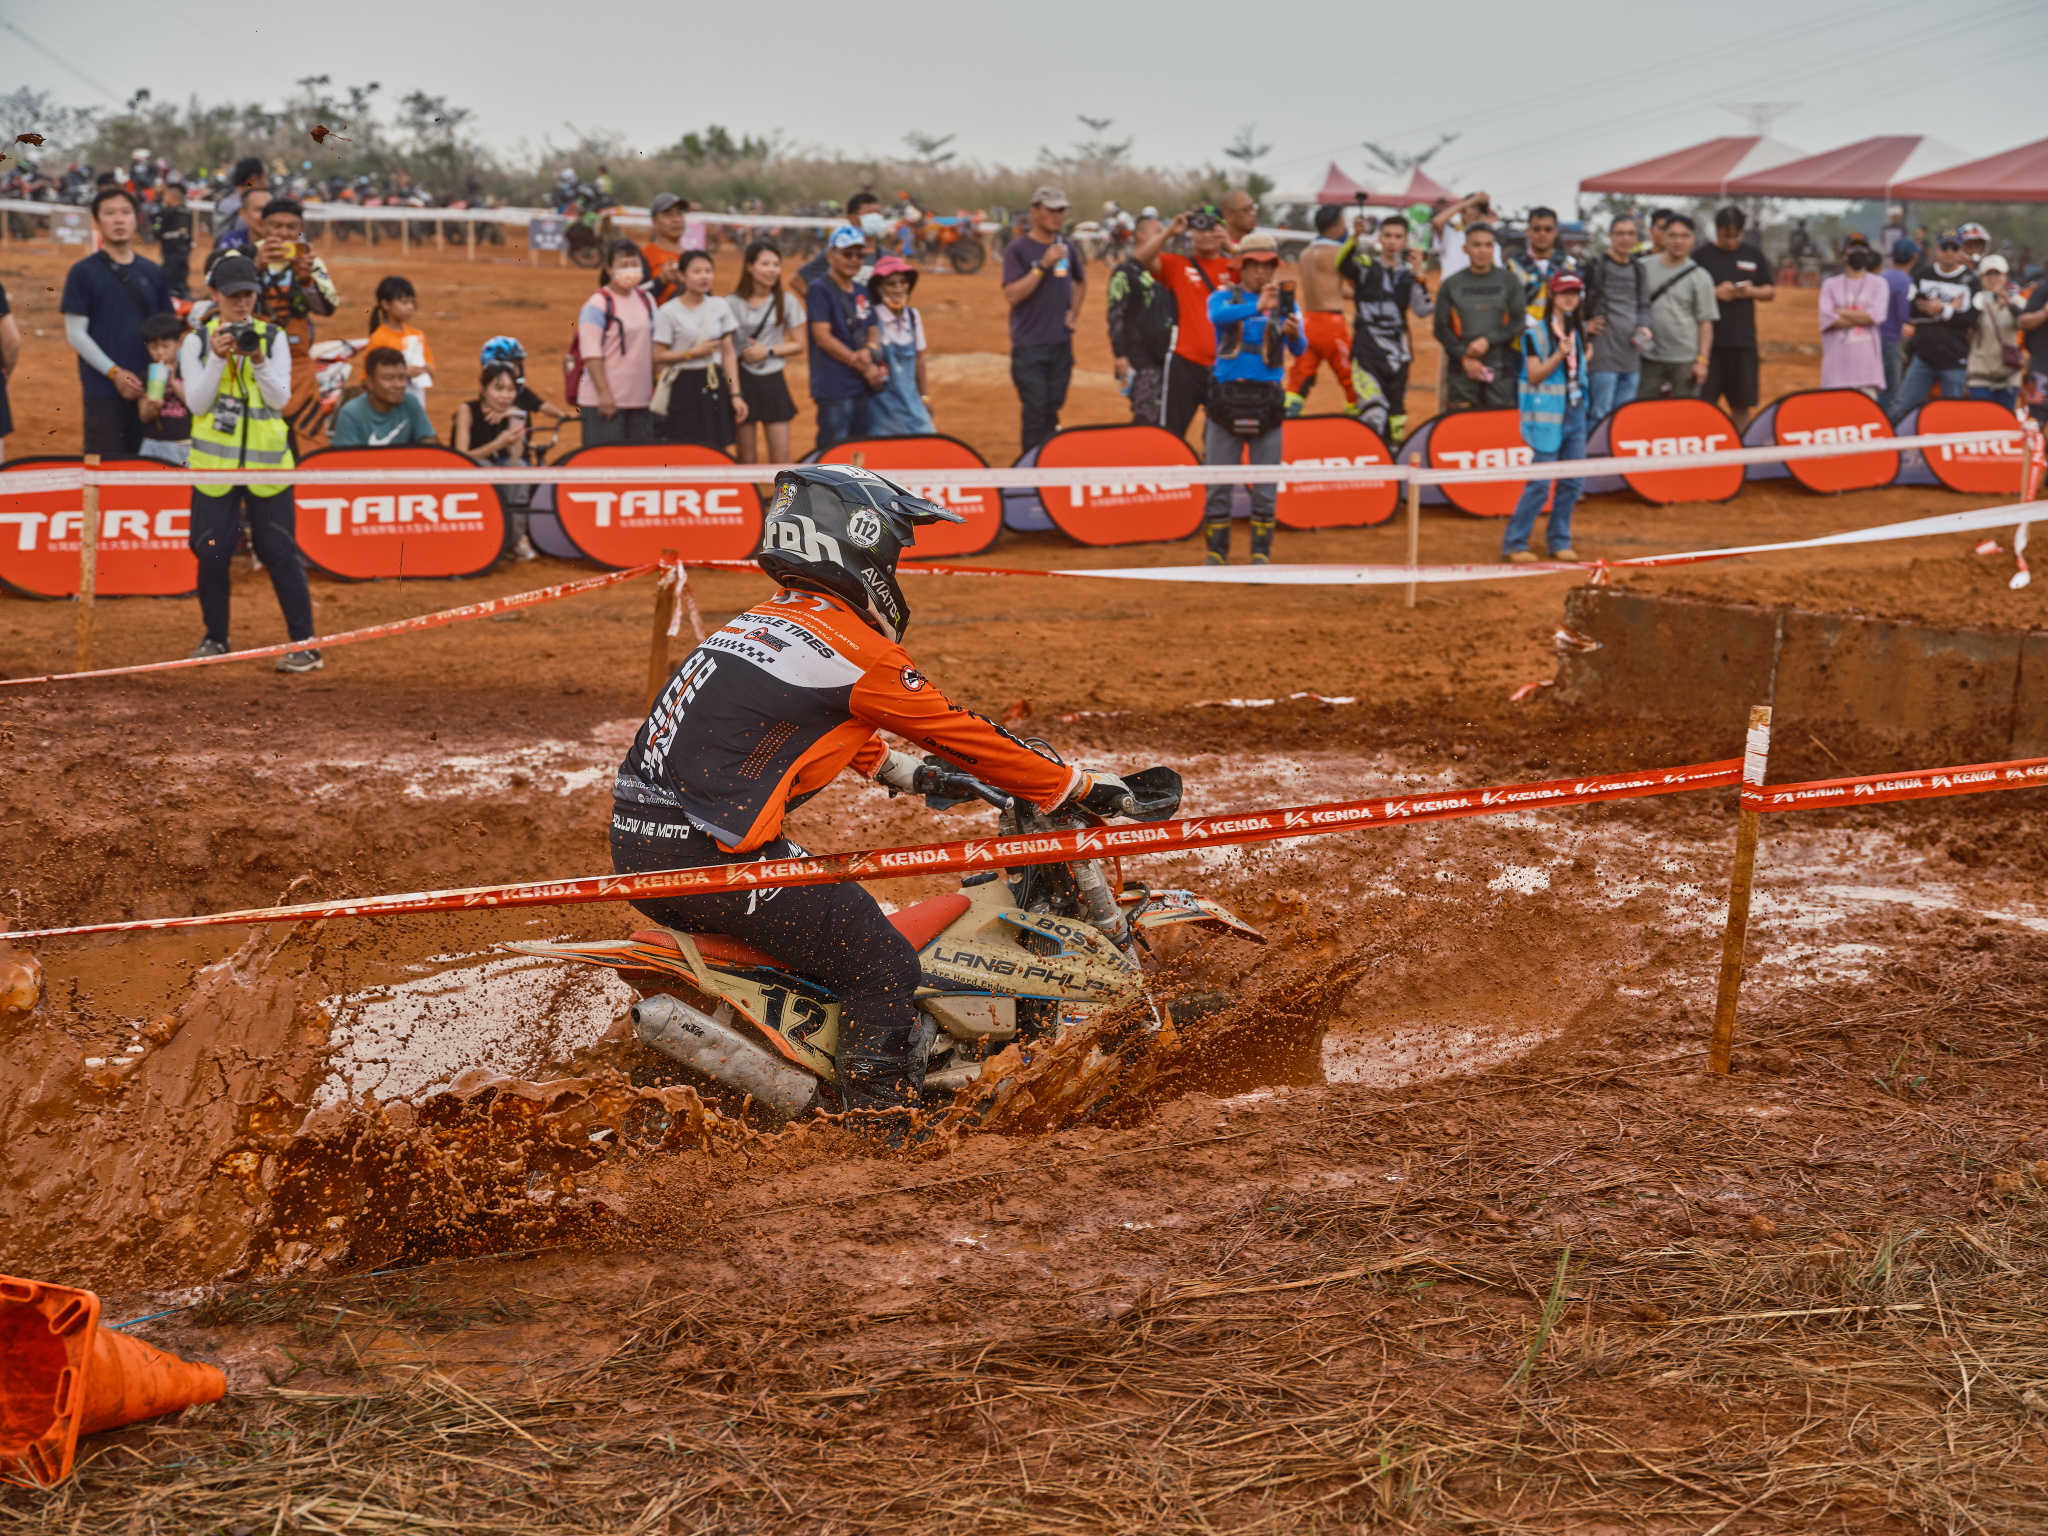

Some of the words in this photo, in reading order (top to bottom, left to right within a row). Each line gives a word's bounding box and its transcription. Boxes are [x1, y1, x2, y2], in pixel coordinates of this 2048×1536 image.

[295, 493, 483, 534] TARC
[568, 489, 743, 527] TARC
[0, 509, 191, 550] TARC
[854, 517, 877, 541] 112
[785, 624, 835, 659] TIRES
[1876, 777, 1924, 793] KENDA
[1952, 769, 1998, 785] KENDA
[612, 812, 641, 833] FOLLOW
[640, 821, 656, 837] ME
[656, 822, 691, 840] MOTO
[502, 883, 582, 900] KENDA
[634, 871, 710, 890] KENDA
[881, 848, 950, 867] KENDA
[995, 837, 1064, 857] KENDA
[1105, 827, 1170, 846] KENDA
[1210, 817, 1273, 835] KENDA
[1312, 807, 1374, 824] KENDA
[1412, 797, 1472, 813] KENDA
[931, 968, 949, 980] Are
[953, 974, 978, 987] Hard
[933, 947, 1017, 976] LANG
[758, 983, 829, 1056] 12
